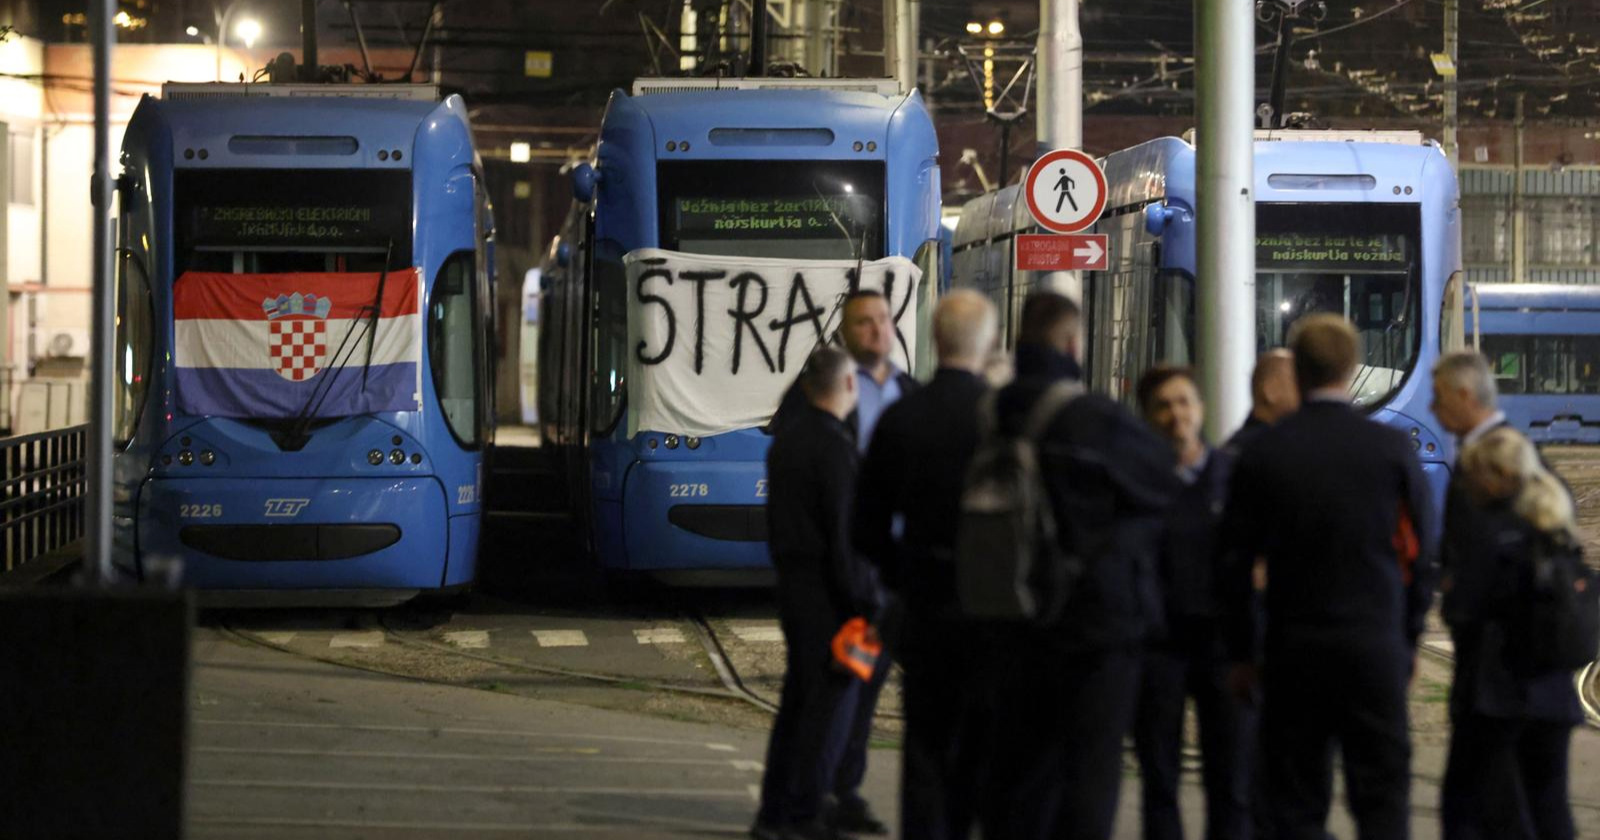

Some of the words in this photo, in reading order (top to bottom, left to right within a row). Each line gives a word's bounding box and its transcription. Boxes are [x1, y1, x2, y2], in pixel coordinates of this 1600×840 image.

[670, 483, 709, 497] 2278
[179, 504, 223, 518] 2226
[264, 498, 310, 517] ZET
